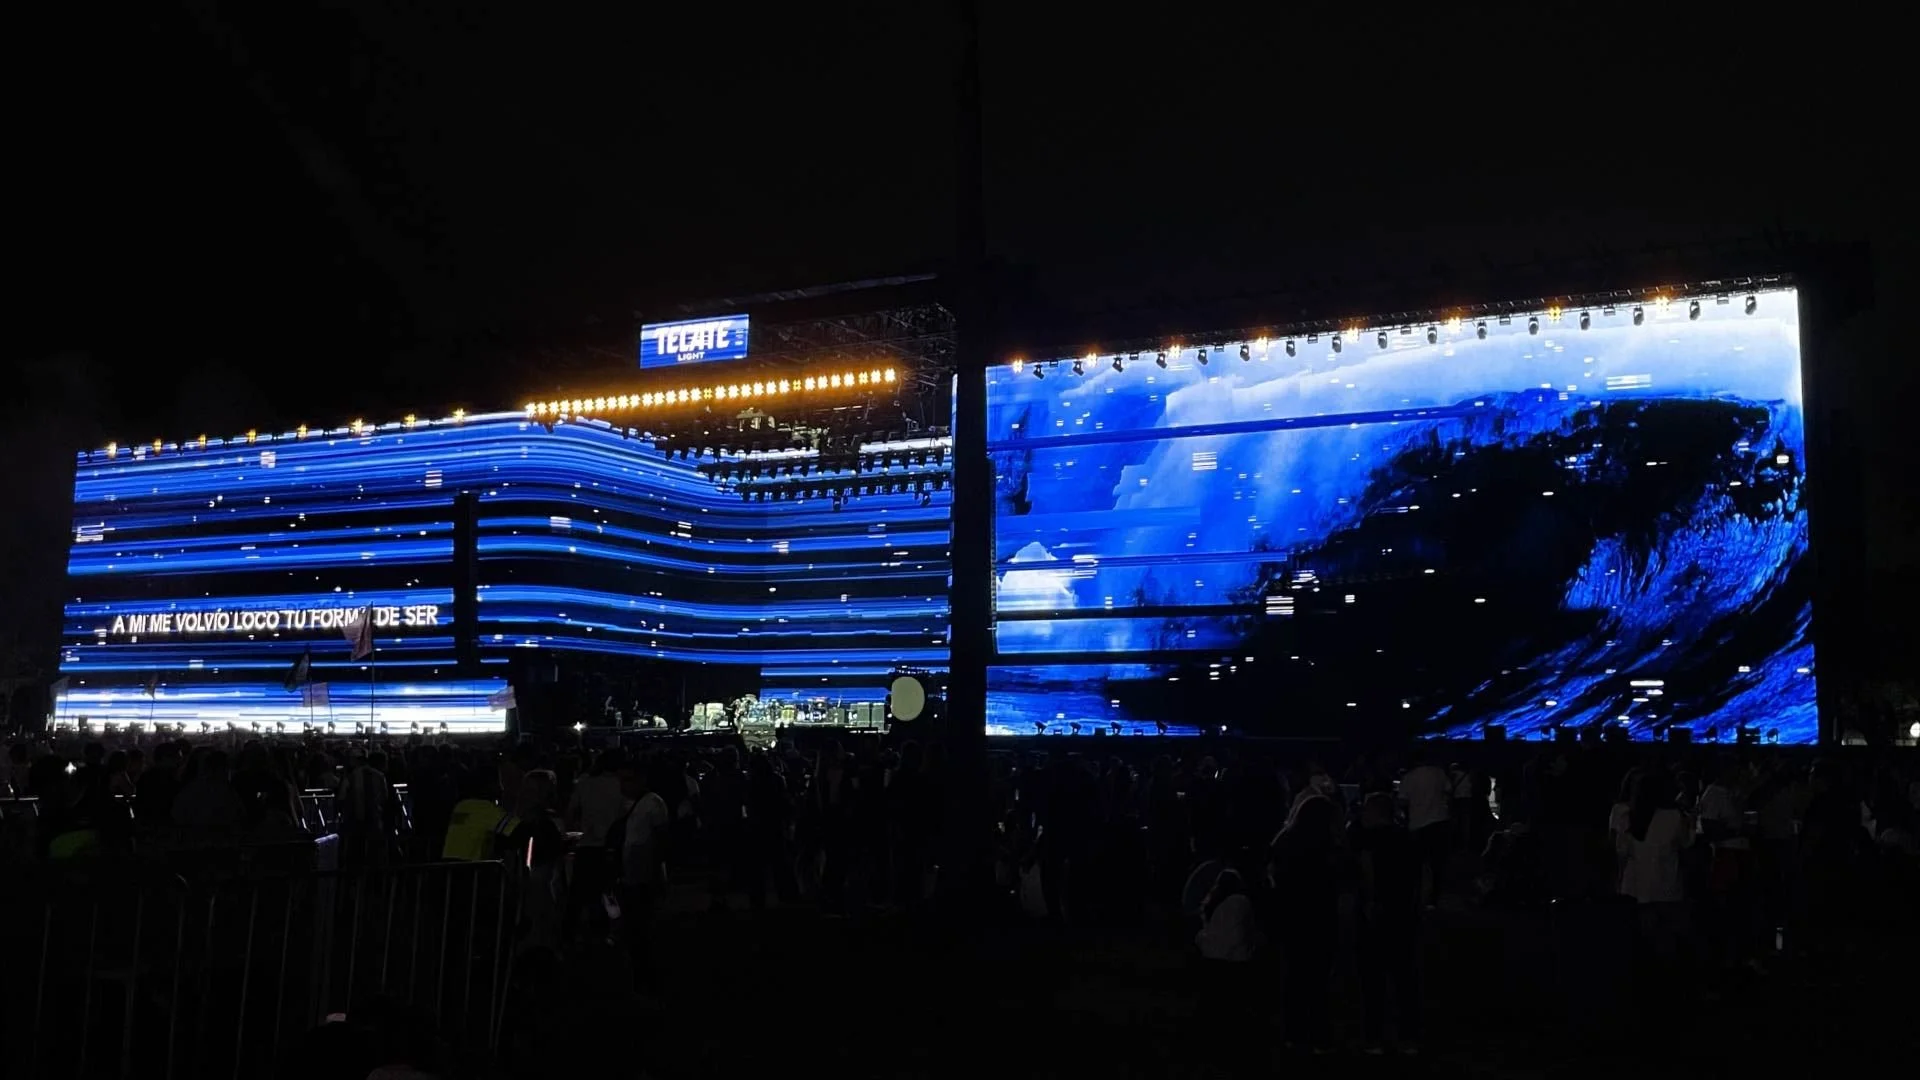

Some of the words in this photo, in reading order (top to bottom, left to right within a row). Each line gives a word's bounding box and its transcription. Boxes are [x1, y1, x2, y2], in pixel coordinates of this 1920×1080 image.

[654, 321, 732, 355] TECATE
[677, 351, 706, 362] LIGHT
[112, 614, 125, 634] A
[150, 613, 172, 633] ME
[175, 608, 230, 632] VOLVÍO
[234, 610, 280, 630] LOCO
[283, 609, 306, 629] TU
[309, 606, 367, 630] FORM
[375, 606, 401, 627] DE
[404, 604, 439, 626] SER
